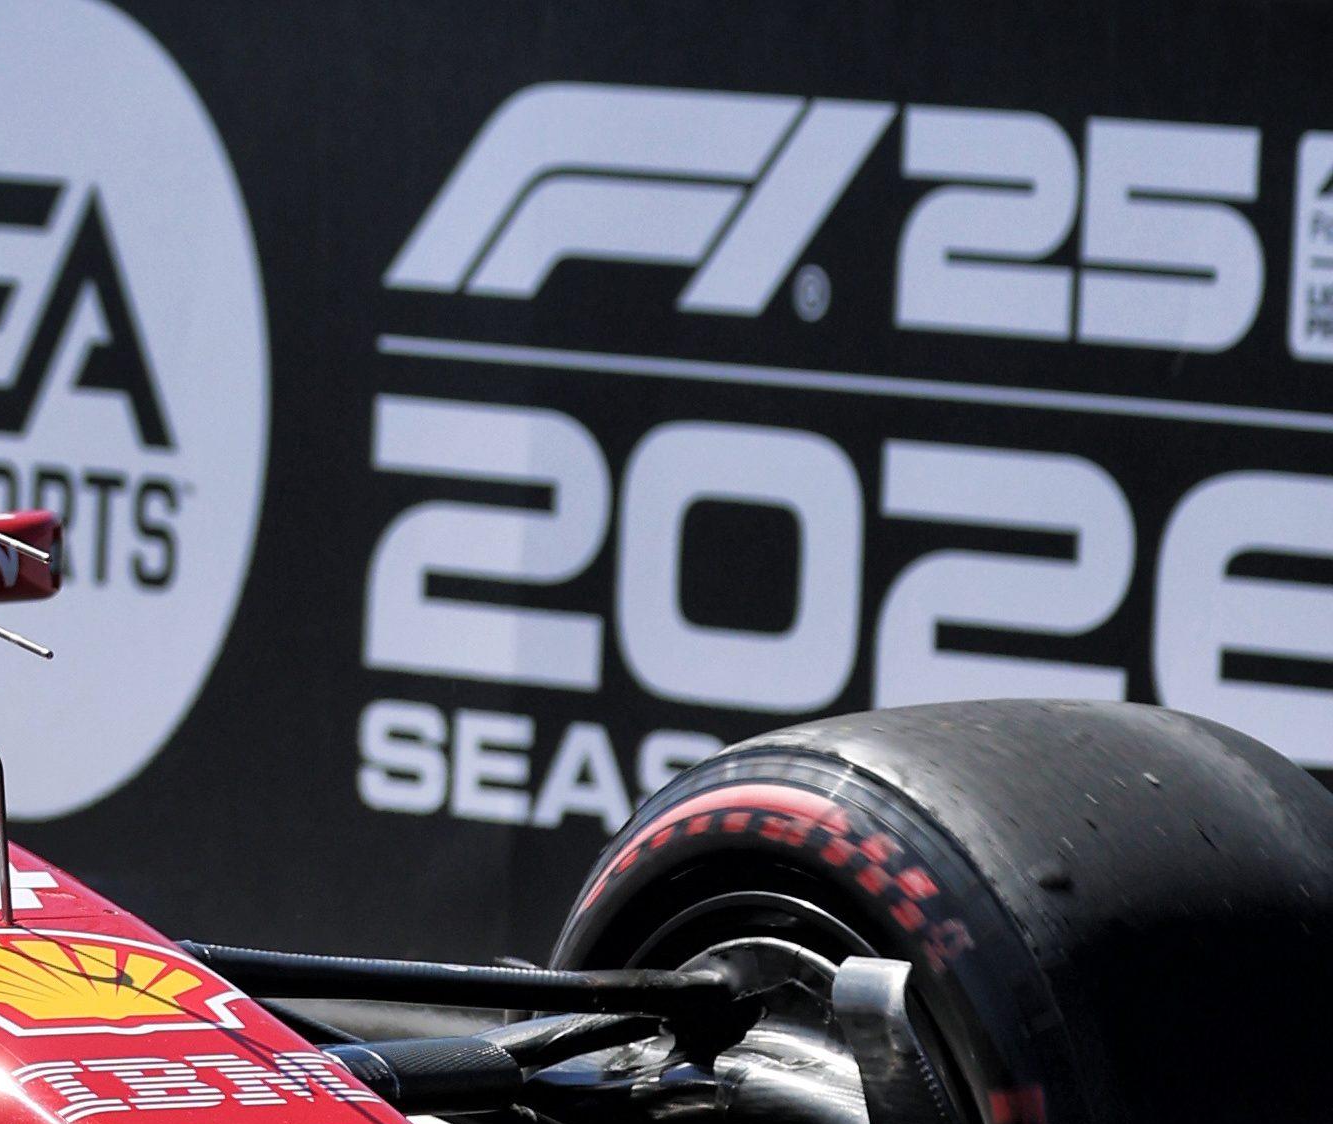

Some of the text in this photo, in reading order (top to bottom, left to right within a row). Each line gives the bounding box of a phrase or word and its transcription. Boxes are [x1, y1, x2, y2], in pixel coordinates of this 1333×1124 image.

[894, 103, 1266, 354] 25
[362, 392, 1333, 770] 2026
[12, 1053, 383, 1123] IBM
